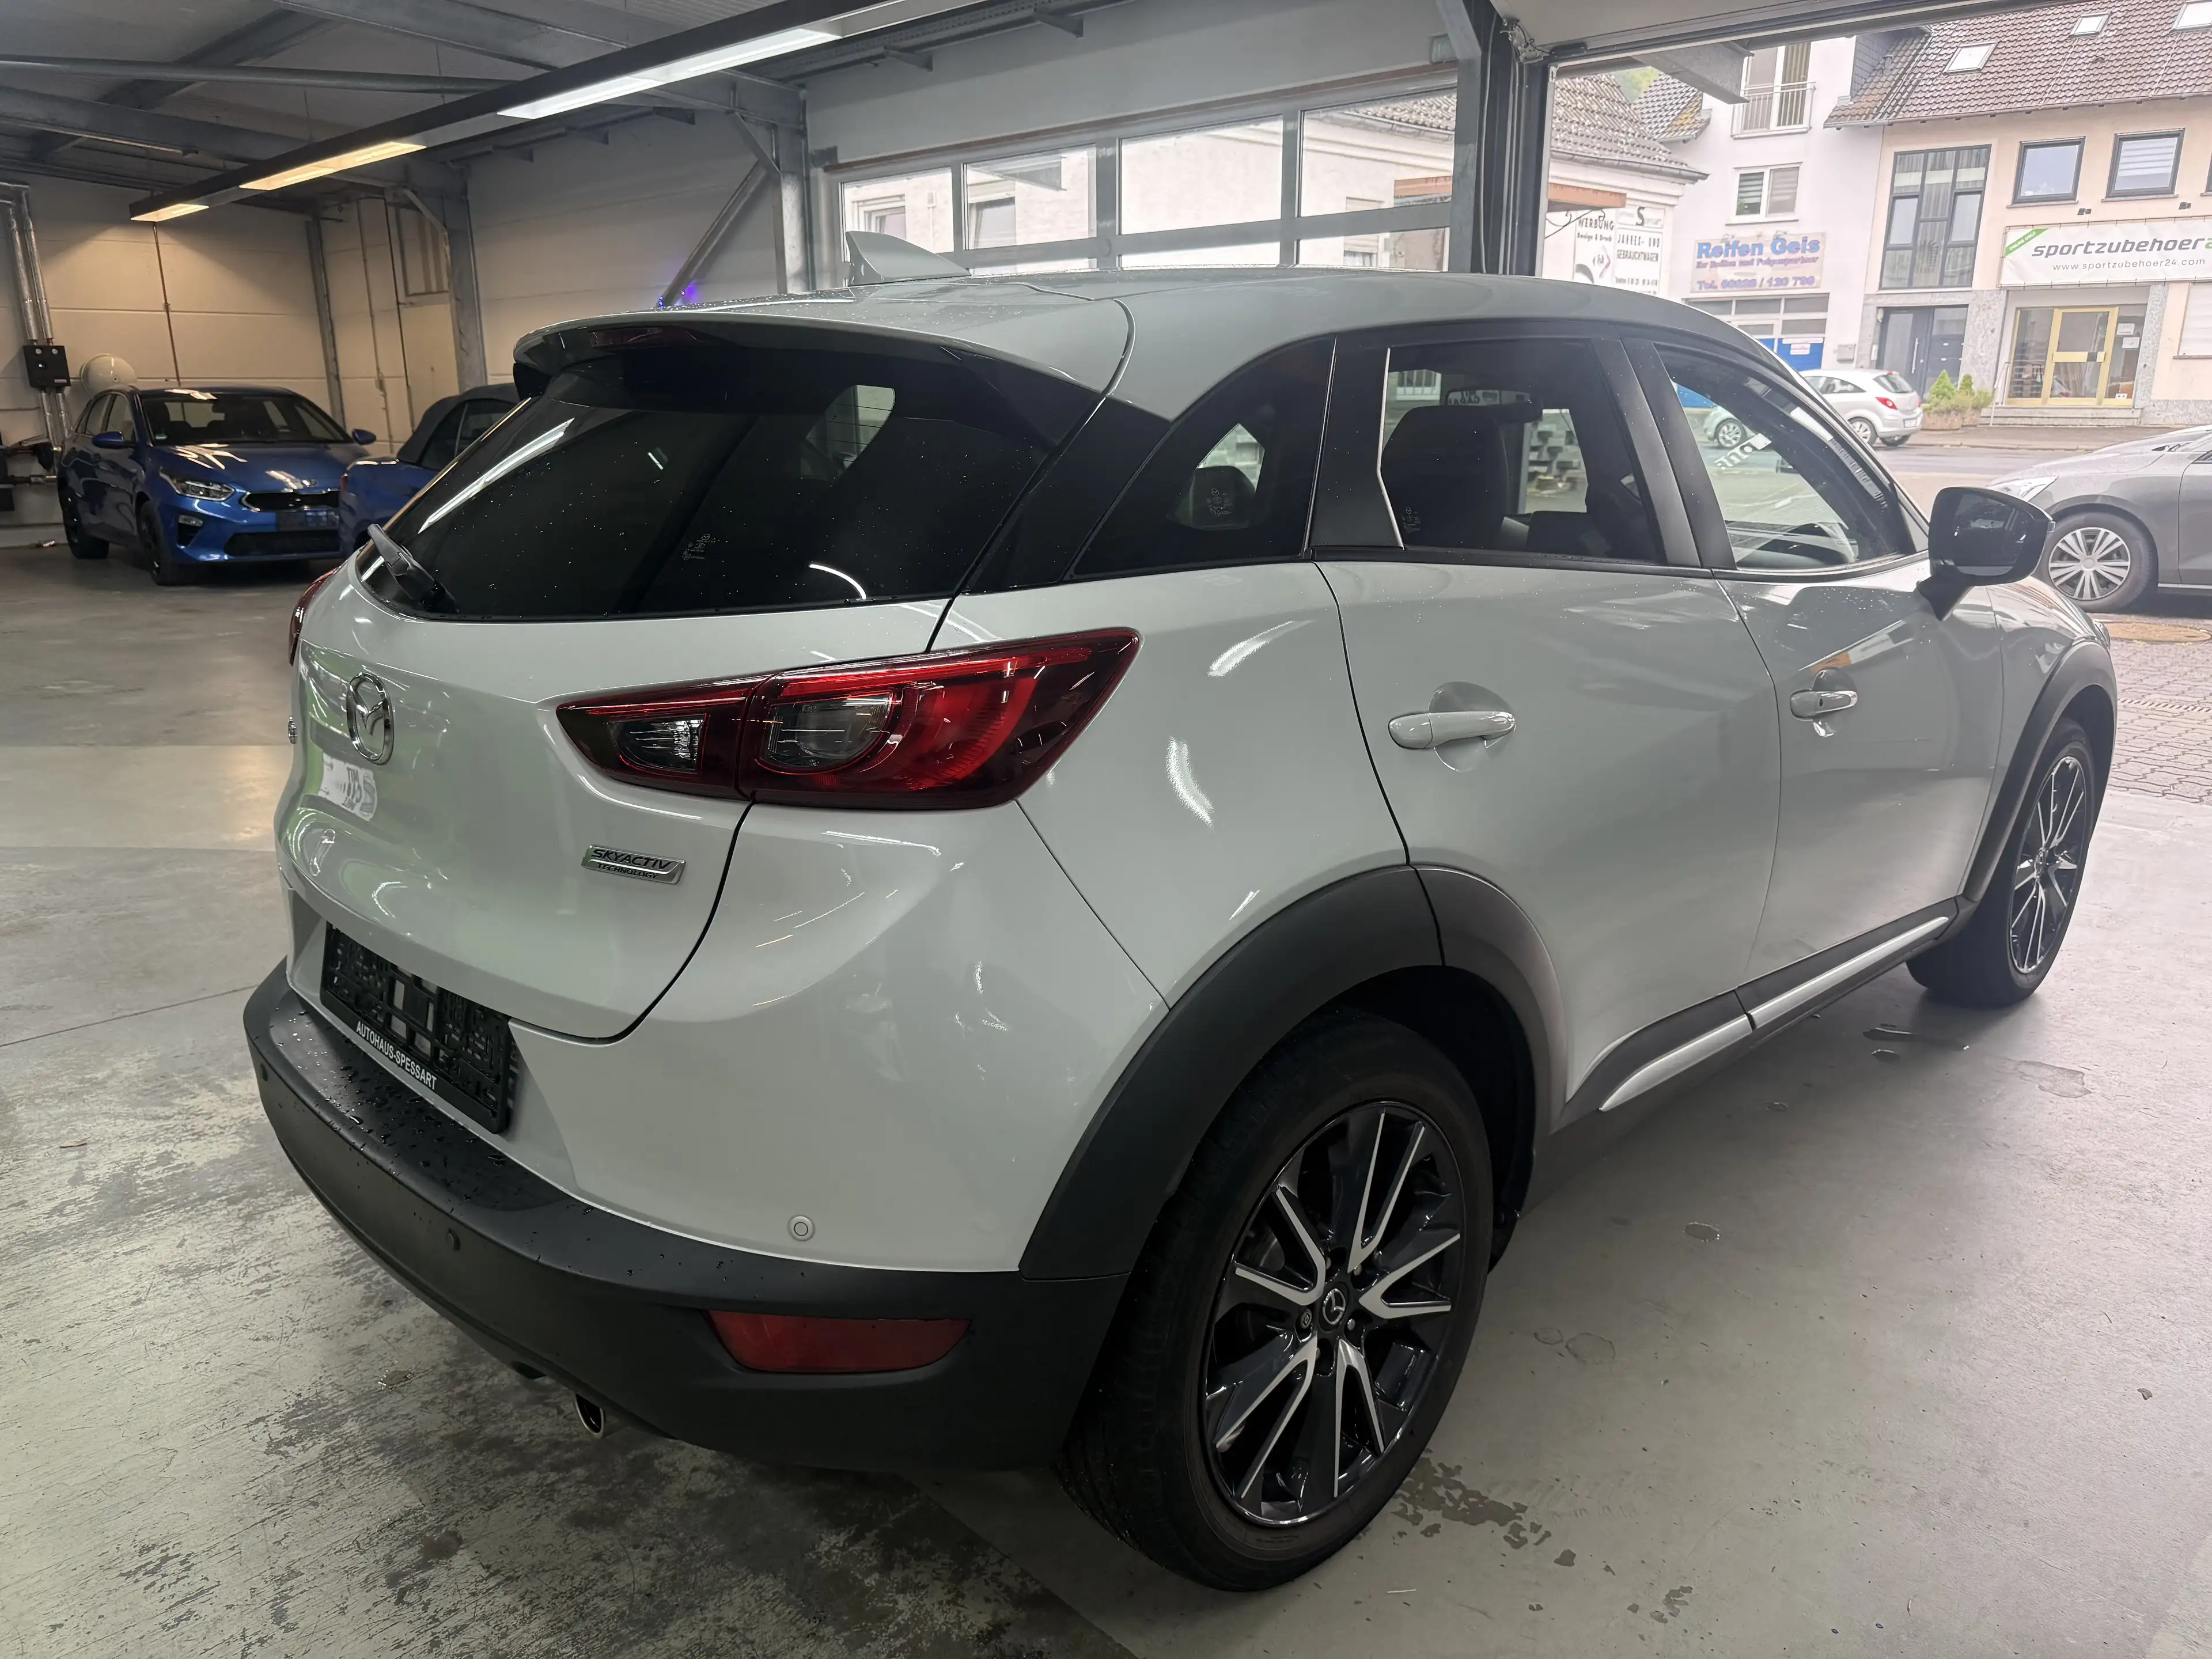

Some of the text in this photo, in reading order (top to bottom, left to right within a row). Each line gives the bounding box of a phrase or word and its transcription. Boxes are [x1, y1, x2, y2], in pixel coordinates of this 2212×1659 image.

[1578, 217, 1614, 230] WERBUNG
[1697, 236, 1820, 259] Reifen Geis
[2053, 259, 2205, 271] wwwsportzubehoer24.com
[1697, 281, 1718, 290] Tel.
[592, 849, 672, 869] SKYACTIV
[598, 863, 659, 878] TECHNOLOGY
[357, 1021, 437, 1090] AUTOHAUS-SPESSART
